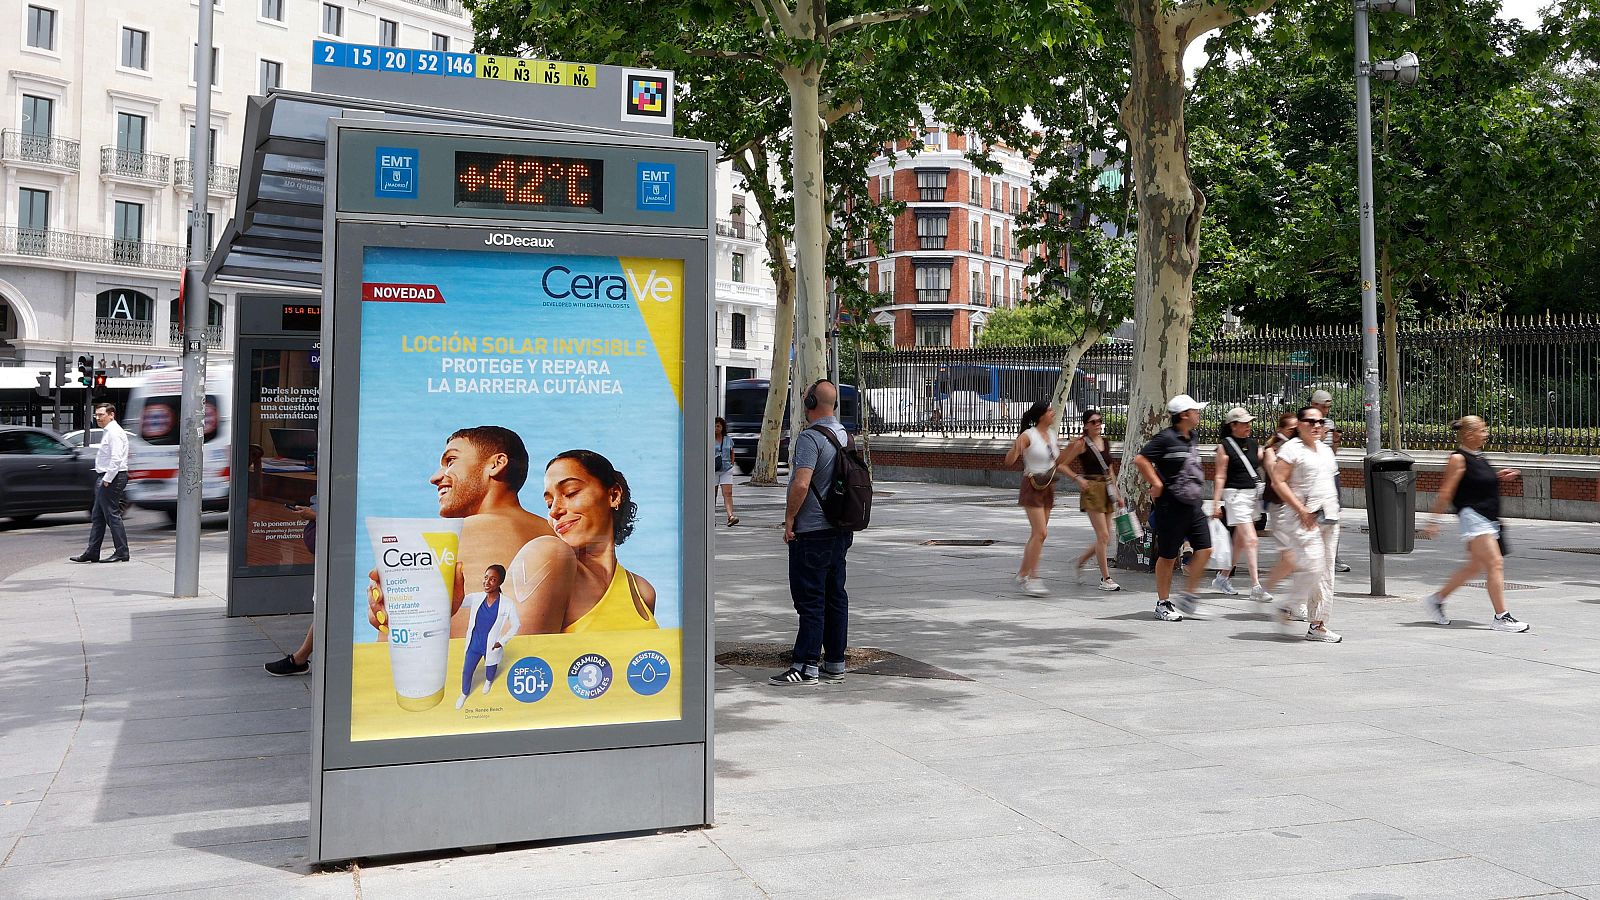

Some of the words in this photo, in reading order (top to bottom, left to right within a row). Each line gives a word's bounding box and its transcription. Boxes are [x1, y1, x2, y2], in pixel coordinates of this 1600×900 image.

[324, 46, 335, 63] 2
[353, 48, 372, 66] 15
[385, 52, 406, 69] 20
[418, 54, 438, 71] 52
[447, 56, 473, 74] 146
[483, 65, 499, 78] N2
[514, 68, 530, 81] N3
[544, 71, 560, 84] N5
[573, 74, 589, 86] N6
[381, 155, 413, 167] EMT
[642, 170, 670, 181] EMT
[484, 233, 555, 248] JCDecaux
[541, 265, 673, 302] CeraVe
[373, 286, 436, 300] NOVEDAD
[111, 293, 133, 320] A
[307, 307, 321, 315] ELI
[402, 331, 477, 353] LOCIÓN
[482, 336, 547, 355] SOLAR
[553, 338, 648, 357] INVISIBLE
[441, 357, 524, 374] PROTEGE
[527, 359, 538, 374] Y
[542, 359, 611, 375] REPARA
[261, 386, 289, 395] Darles
[290, 386, 300, 395] lo
[427, 377, 451, 393] LA
[455, 378, 540, 394] BARRERA
[544, 375, 623, 395] CUTÁNEA
[273, 395, 307, 403] debería
[278, 403, 316, 411] cuestión
[260, 411, 318, 420] matemáticas
[383, 547, 455, 568] CeraVe
[385, 577, 408, 586] Loción
[386, 586, 420, 594] Protectora
[388, 602, 420, 610] Hidratante
[570, 655, 607, 675] CERAMIDAS
[631, 652, 666, 667] RESISTENTE
[514, 667, 530, 676] SPF
[582, 665, 598, 688] 3
[513, 675, 549, 695] 50+
[572, 676, 610, 697] ESENCIALES
